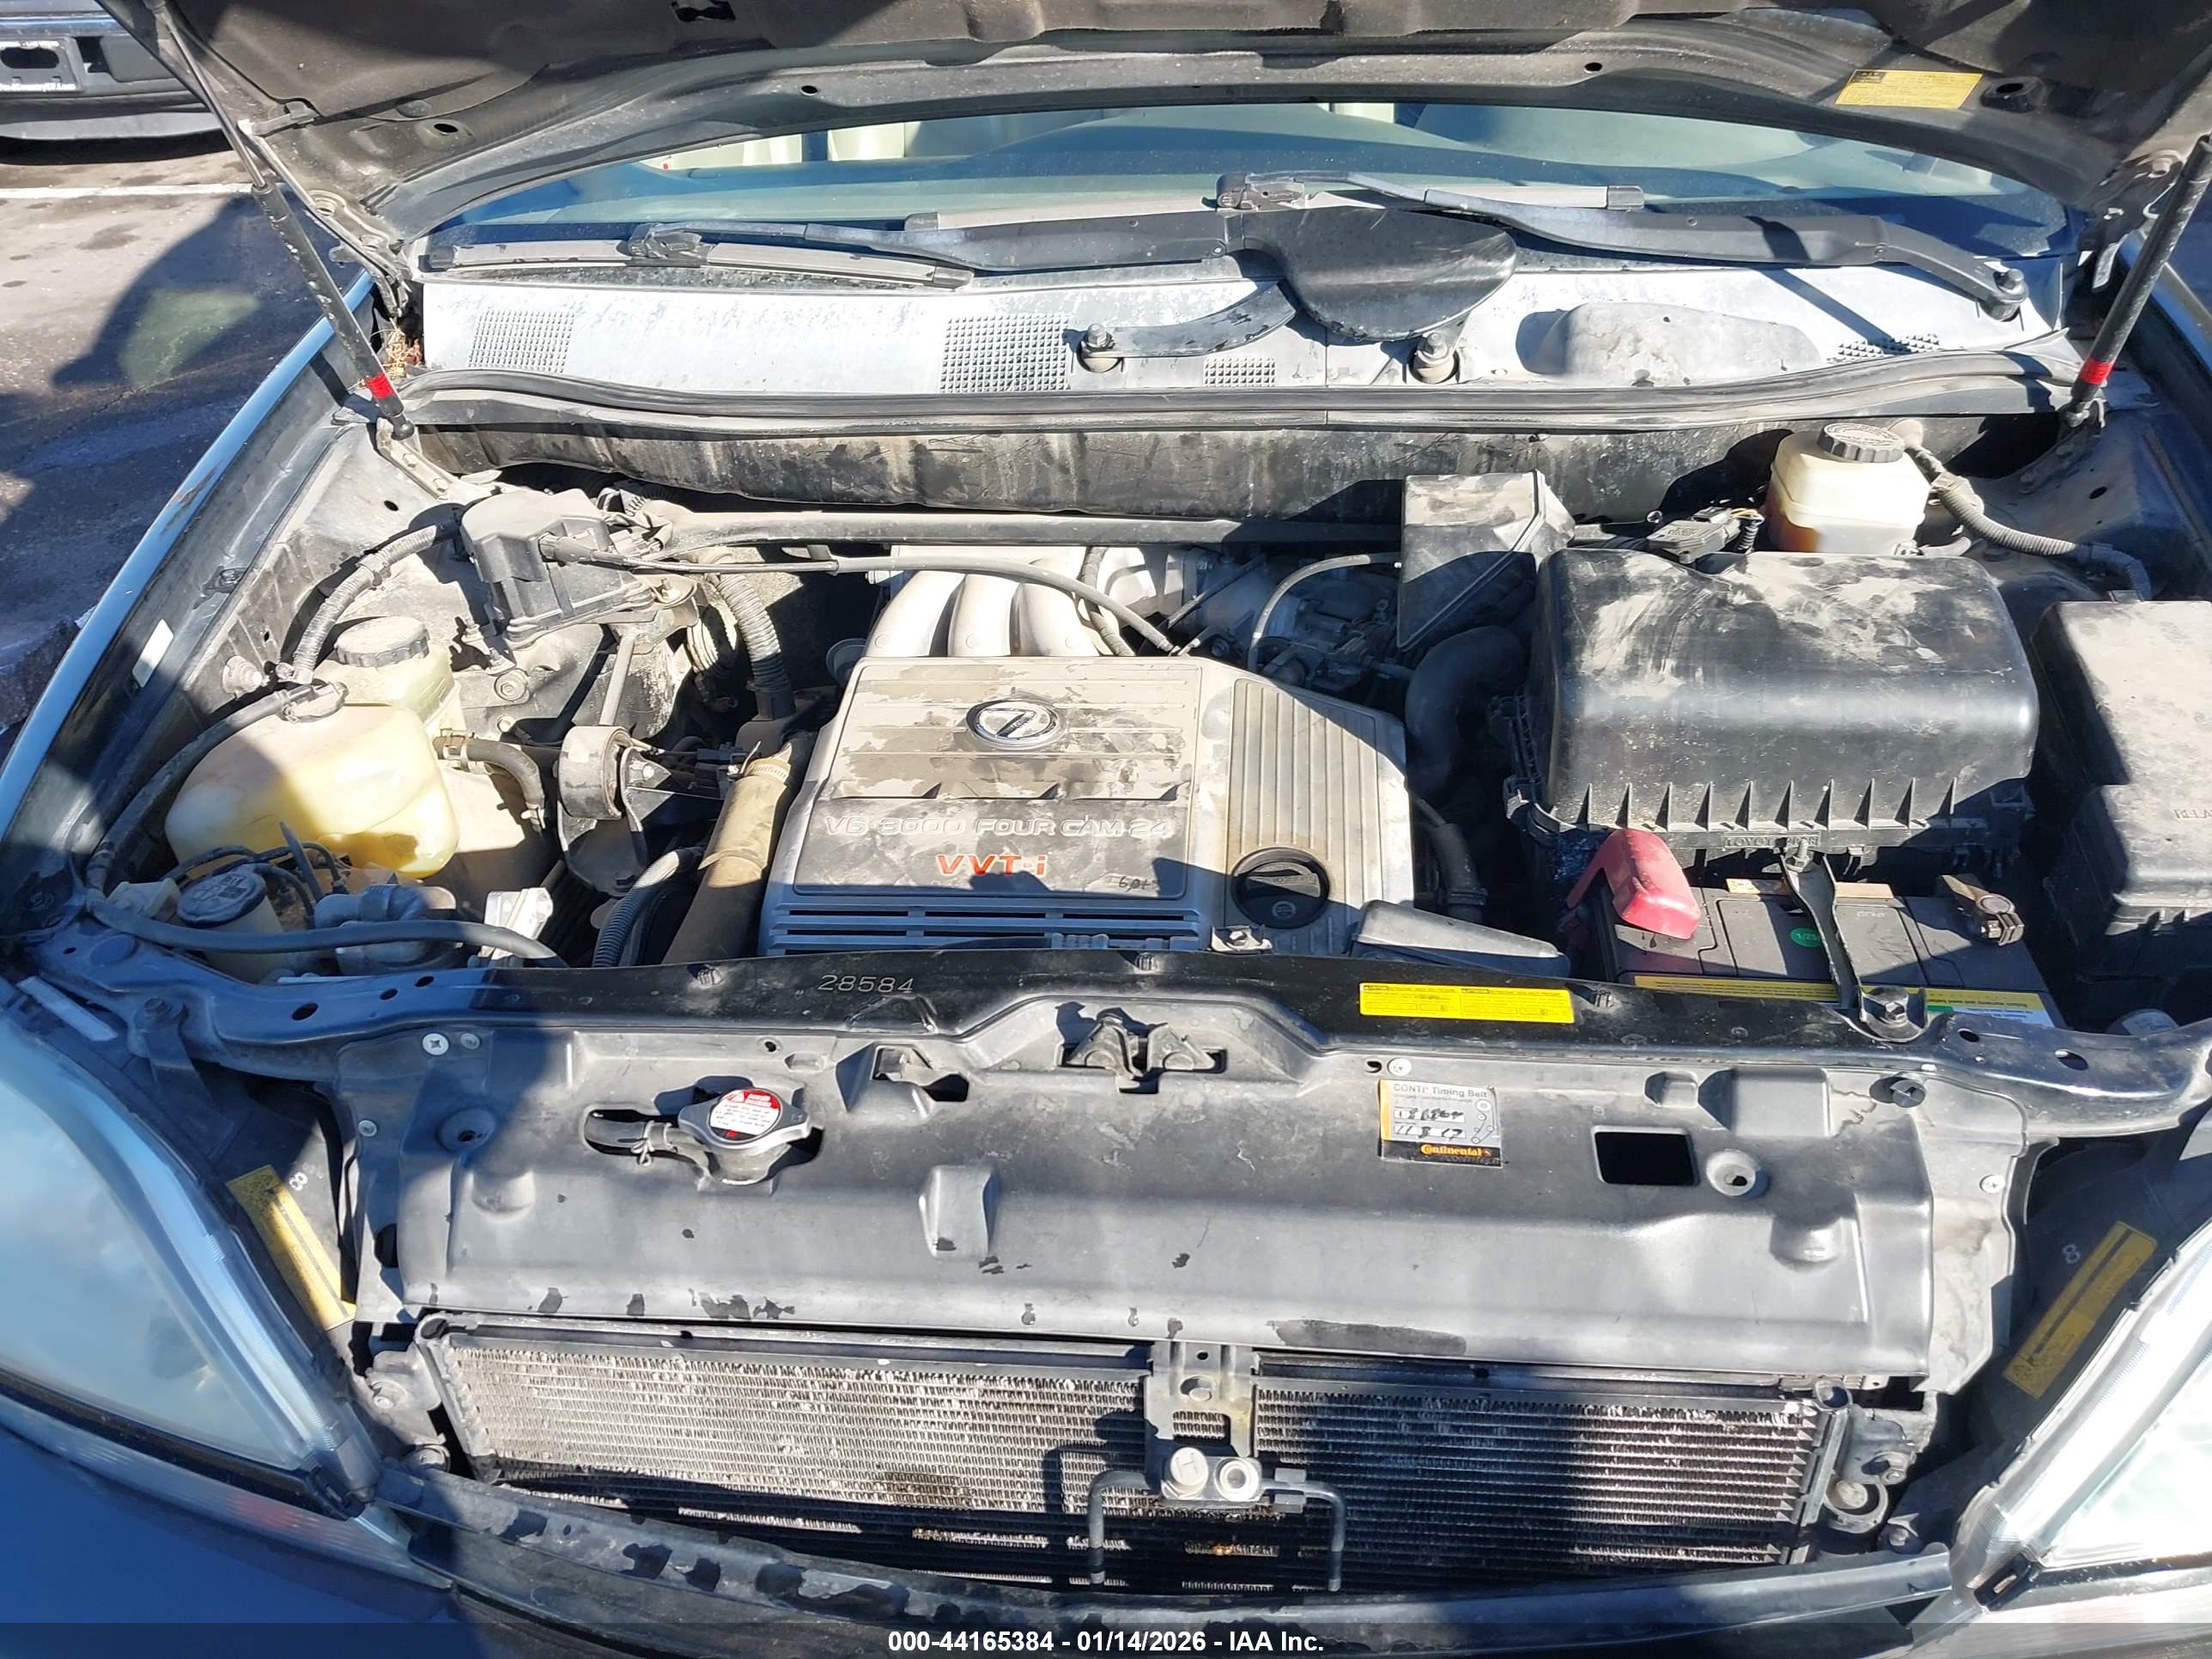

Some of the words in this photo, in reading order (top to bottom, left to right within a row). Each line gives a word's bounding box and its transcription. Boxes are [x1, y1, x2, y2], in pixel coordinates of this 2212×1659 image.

[824, 816, 869, 836] V6
[878, 817, 966, 836] 3000
[973, 817, 1056, 836] FOUR
[1060, 817, 1127, 837] CAM
[1128, 817, 1176, 839] 24
[934, 853, 1048, 876] VVT-i
[817, 974, 915, 994] 28584
[1431, 1085, 1466, 1098] Timing
[1468, 1089, 1488, 1098] Belt
[1420, 1143, 1483, 1157] Continental
